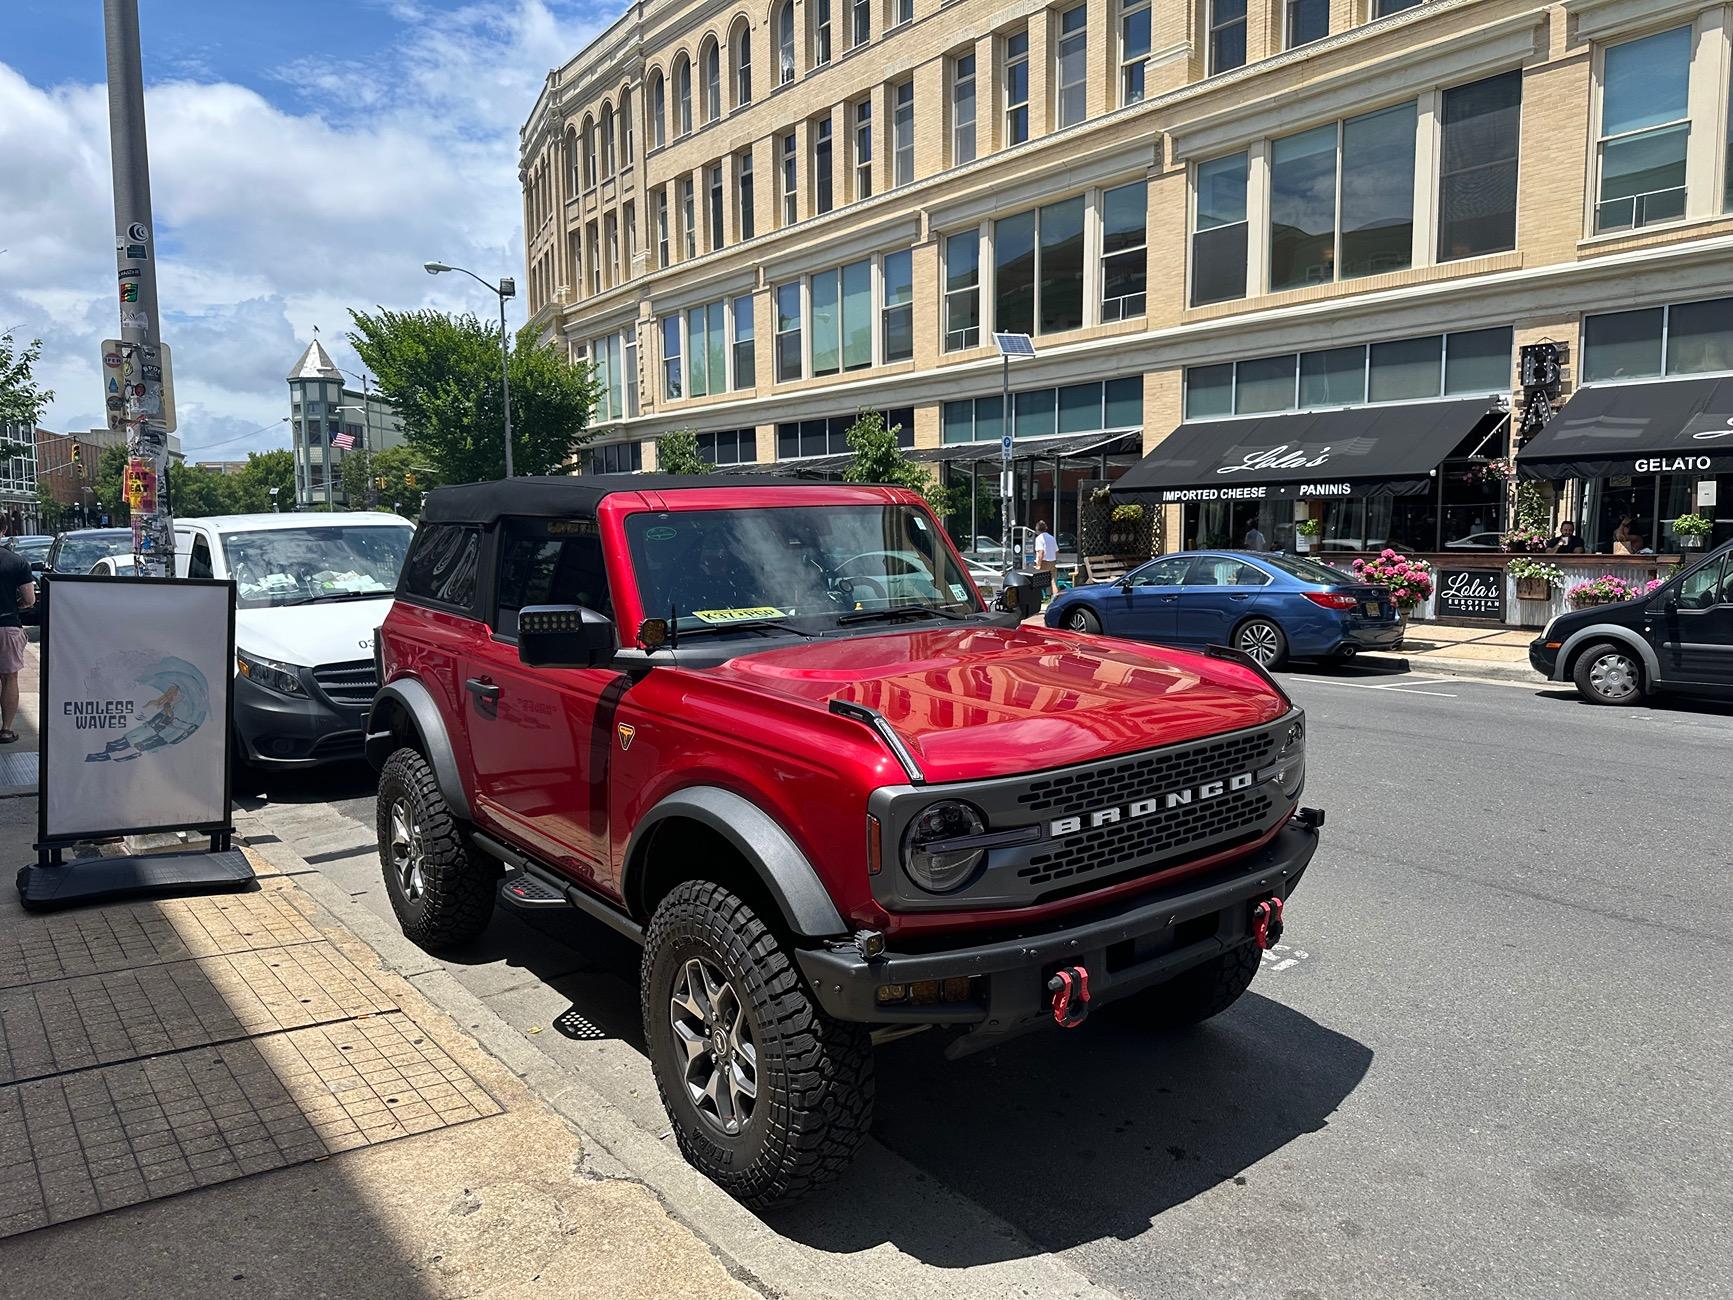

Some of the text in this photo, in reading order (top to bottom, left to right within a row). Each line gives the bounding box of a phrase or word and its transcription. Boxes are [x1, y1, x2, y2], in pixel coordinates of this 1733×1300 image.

[1217, 445, 1331, 474] Lola's
[1634, 456, 1711, 472] GELATO
[1162, 483, 1351, 501] IMPORTED CHEESE PANINIS
[1441, 572, 1499, 598] Lola's
[1448, 599, 1500, 607] EUROPEAN
[64, 700, 134, 715] ENDLESS
[75, 714, 127, 729] WAVES
[1051, 772, 1252, 836] BRONCO
